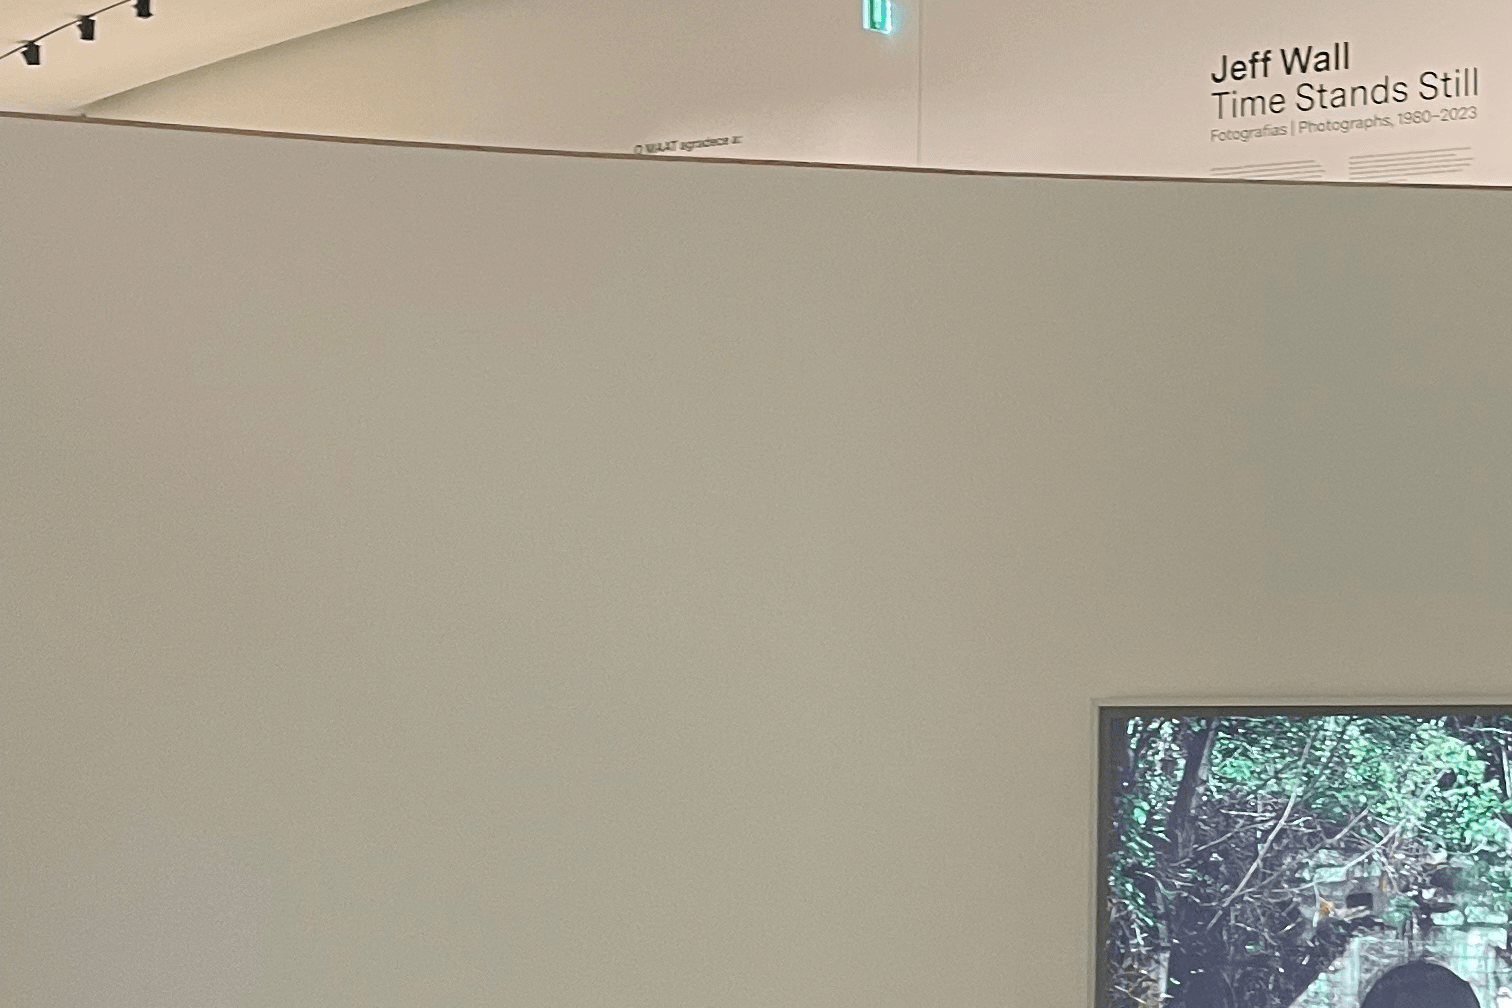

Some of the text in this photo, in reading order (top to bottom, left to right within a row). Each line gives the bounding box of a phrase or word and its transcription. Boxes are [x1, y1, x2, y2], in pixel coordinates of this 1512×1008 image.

[1211, 41, 1350, 83] Jeff Wall
[1211, 67, 1479, 119] Time Stands Still
